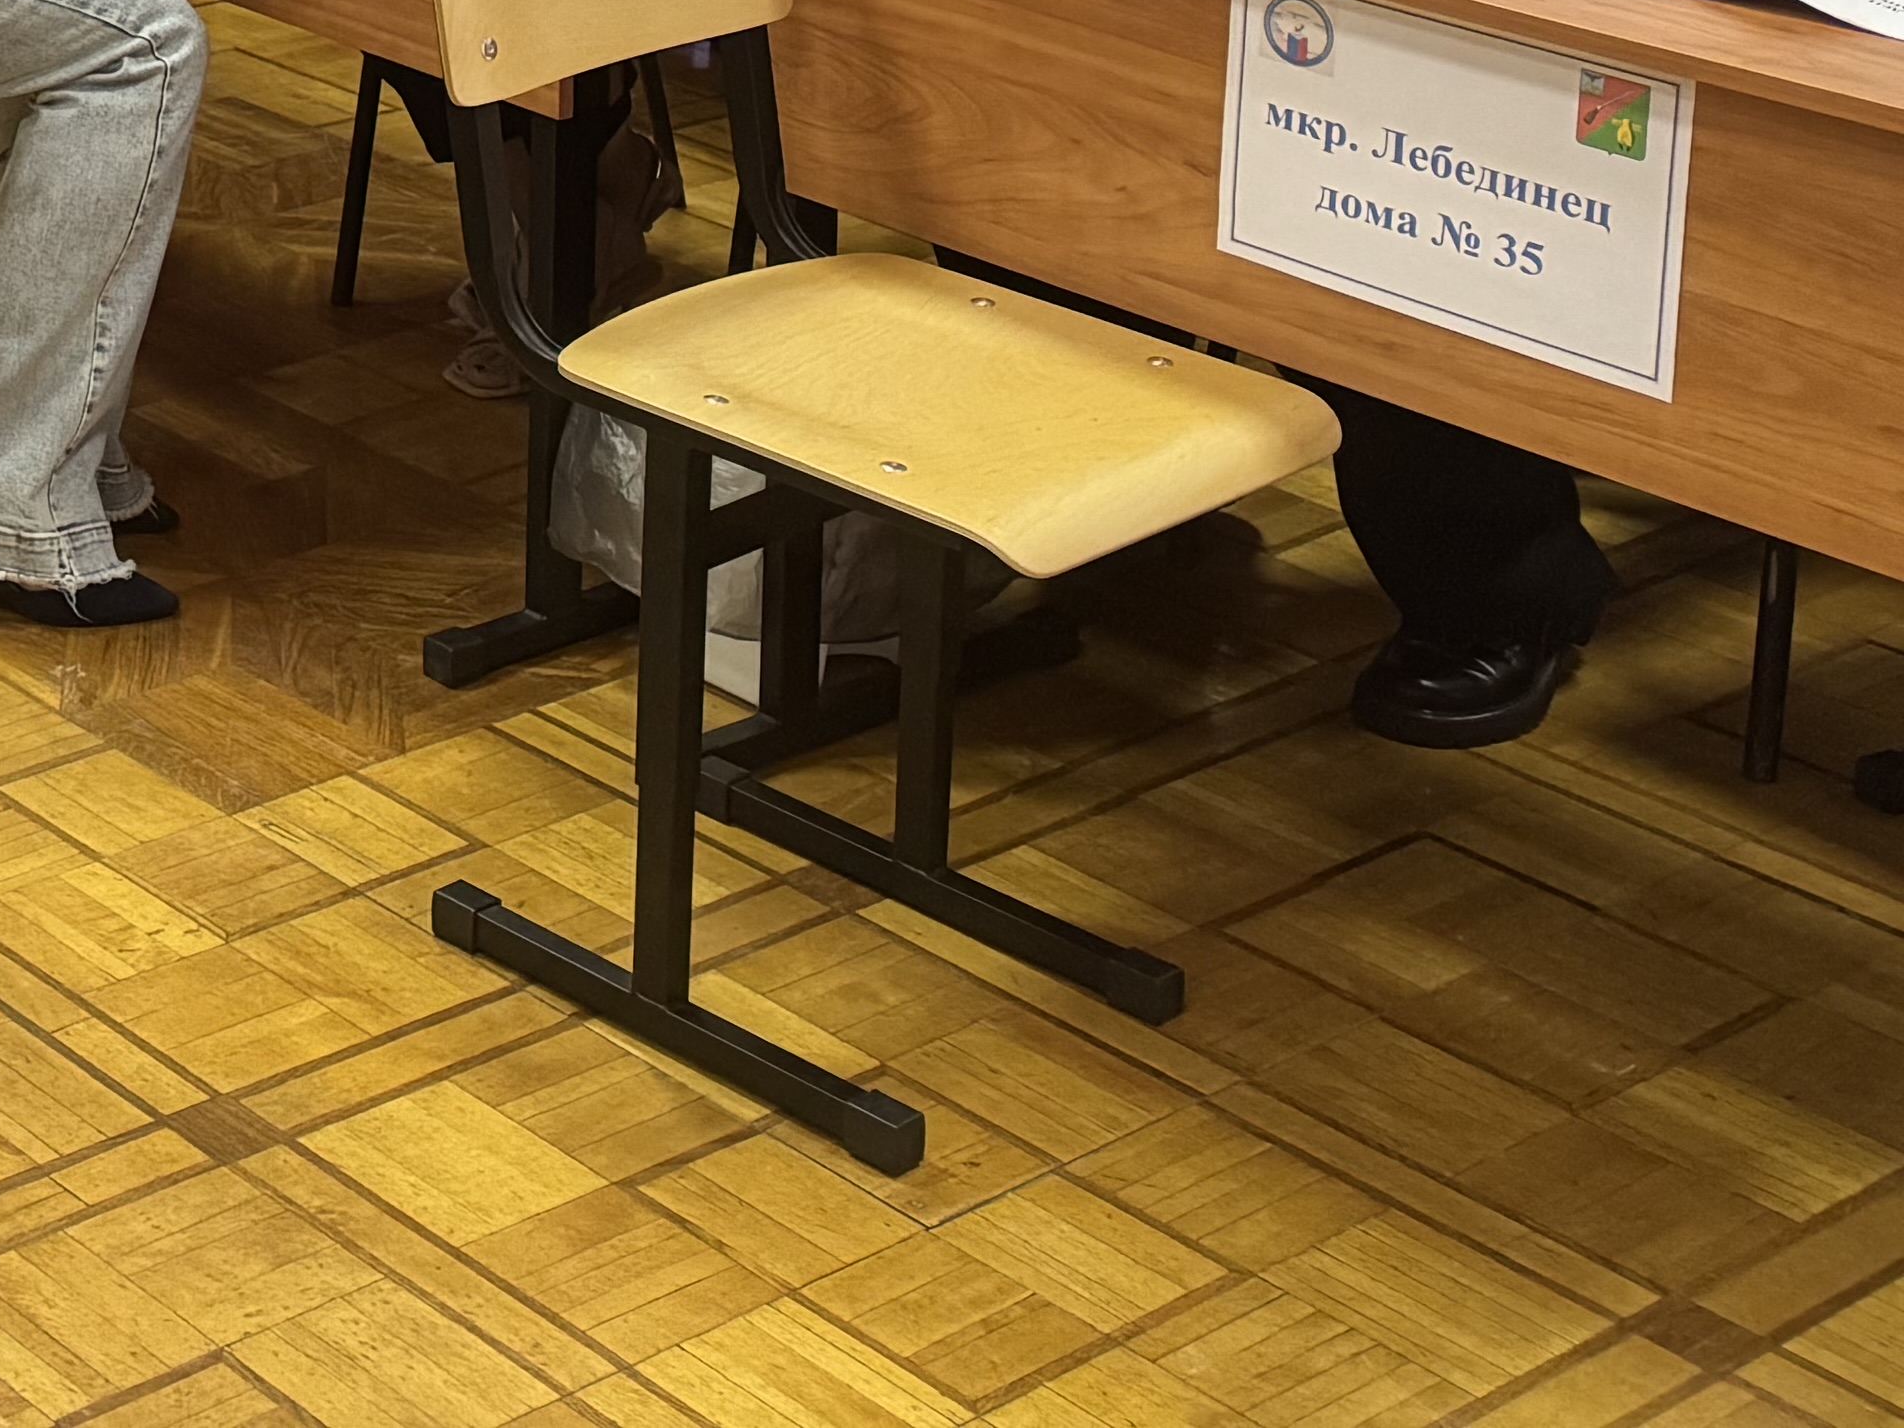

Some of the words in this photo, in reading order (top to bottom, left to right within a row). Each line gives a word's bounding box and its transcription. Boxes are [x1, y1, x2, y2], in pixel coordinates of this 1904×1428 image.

[1264, 101, 1359, 153] мкр.
[1371, 126, 1612, 233] Лебединец
[1314, 185, 1419, 239] дома
[1430, 212, 1482, 258] №
[1493, 233, 1545, 276] 35
